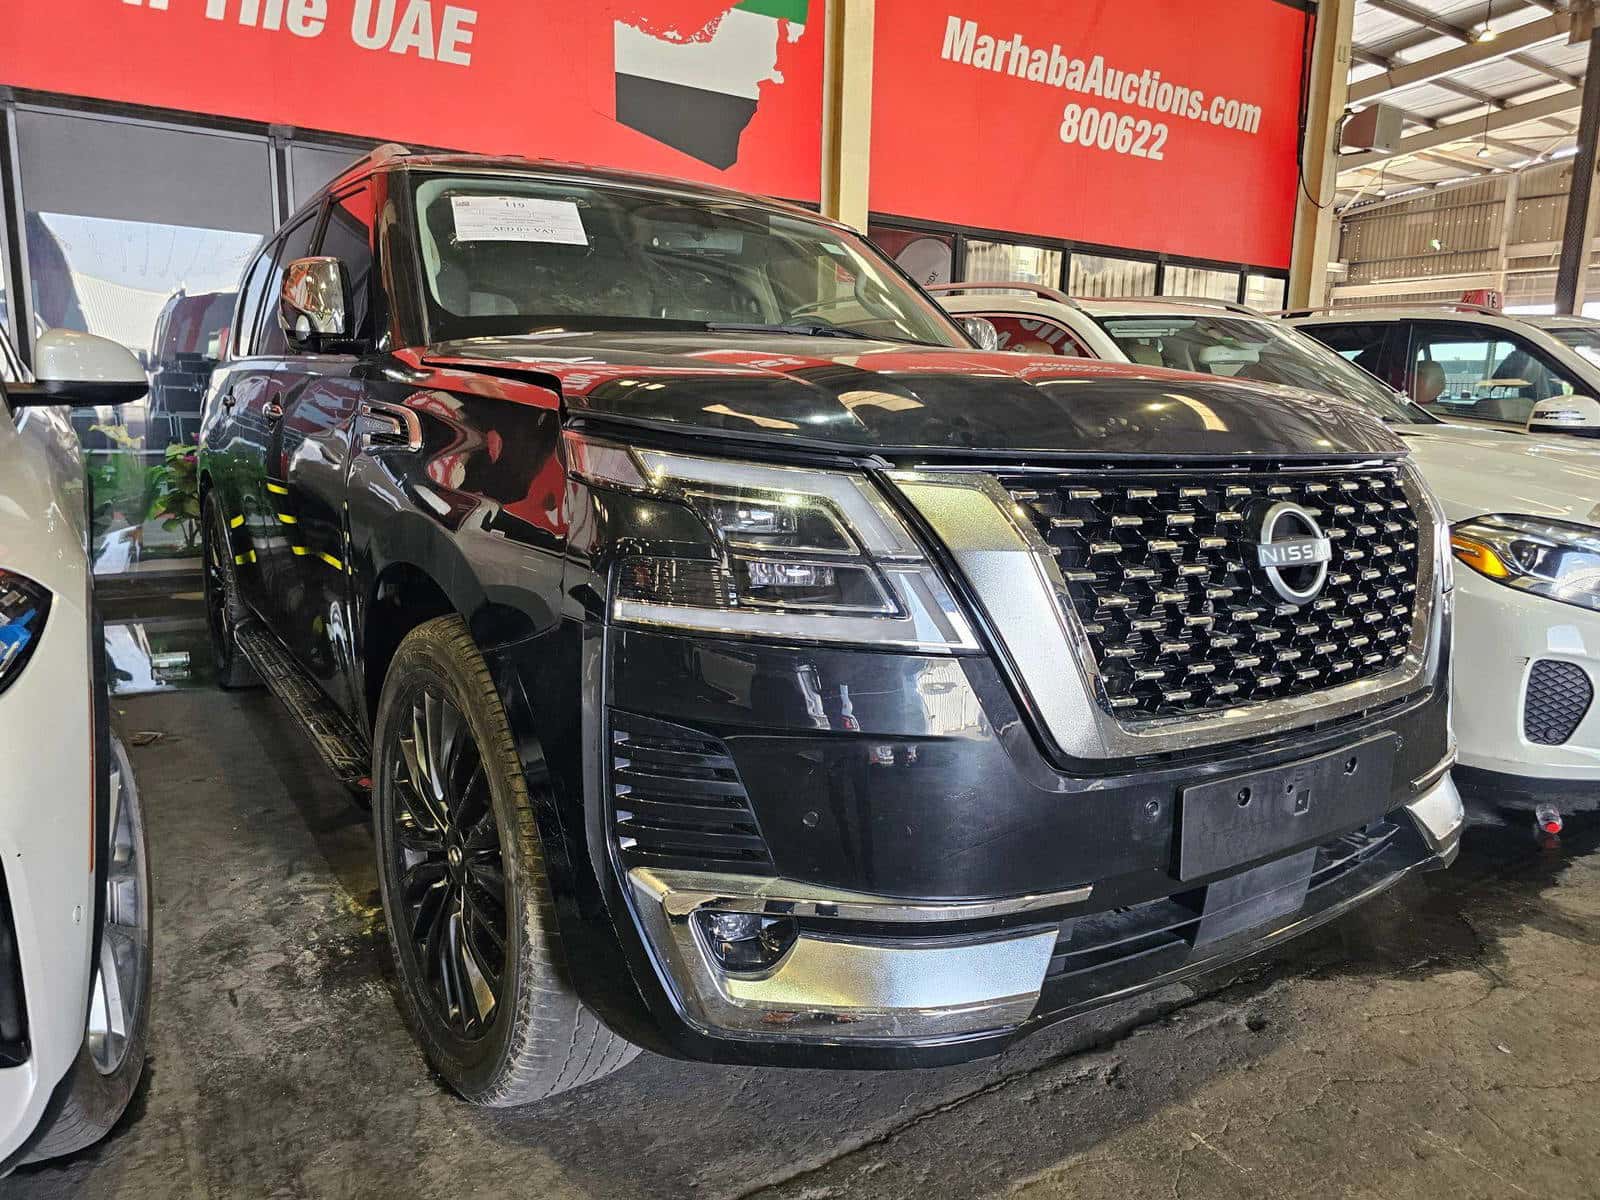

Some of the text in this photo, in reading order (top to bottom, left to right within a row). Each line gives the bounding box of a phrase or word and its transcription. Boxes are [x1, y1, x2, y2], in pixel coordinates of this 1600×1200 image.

[351, 0, 477, 66] UAE
[941, 15, 1262, 134] MarhabaAuctions.com
[1059, 103, 1169, 161] 800622
[1261, 543, 1331, 563] NISS
